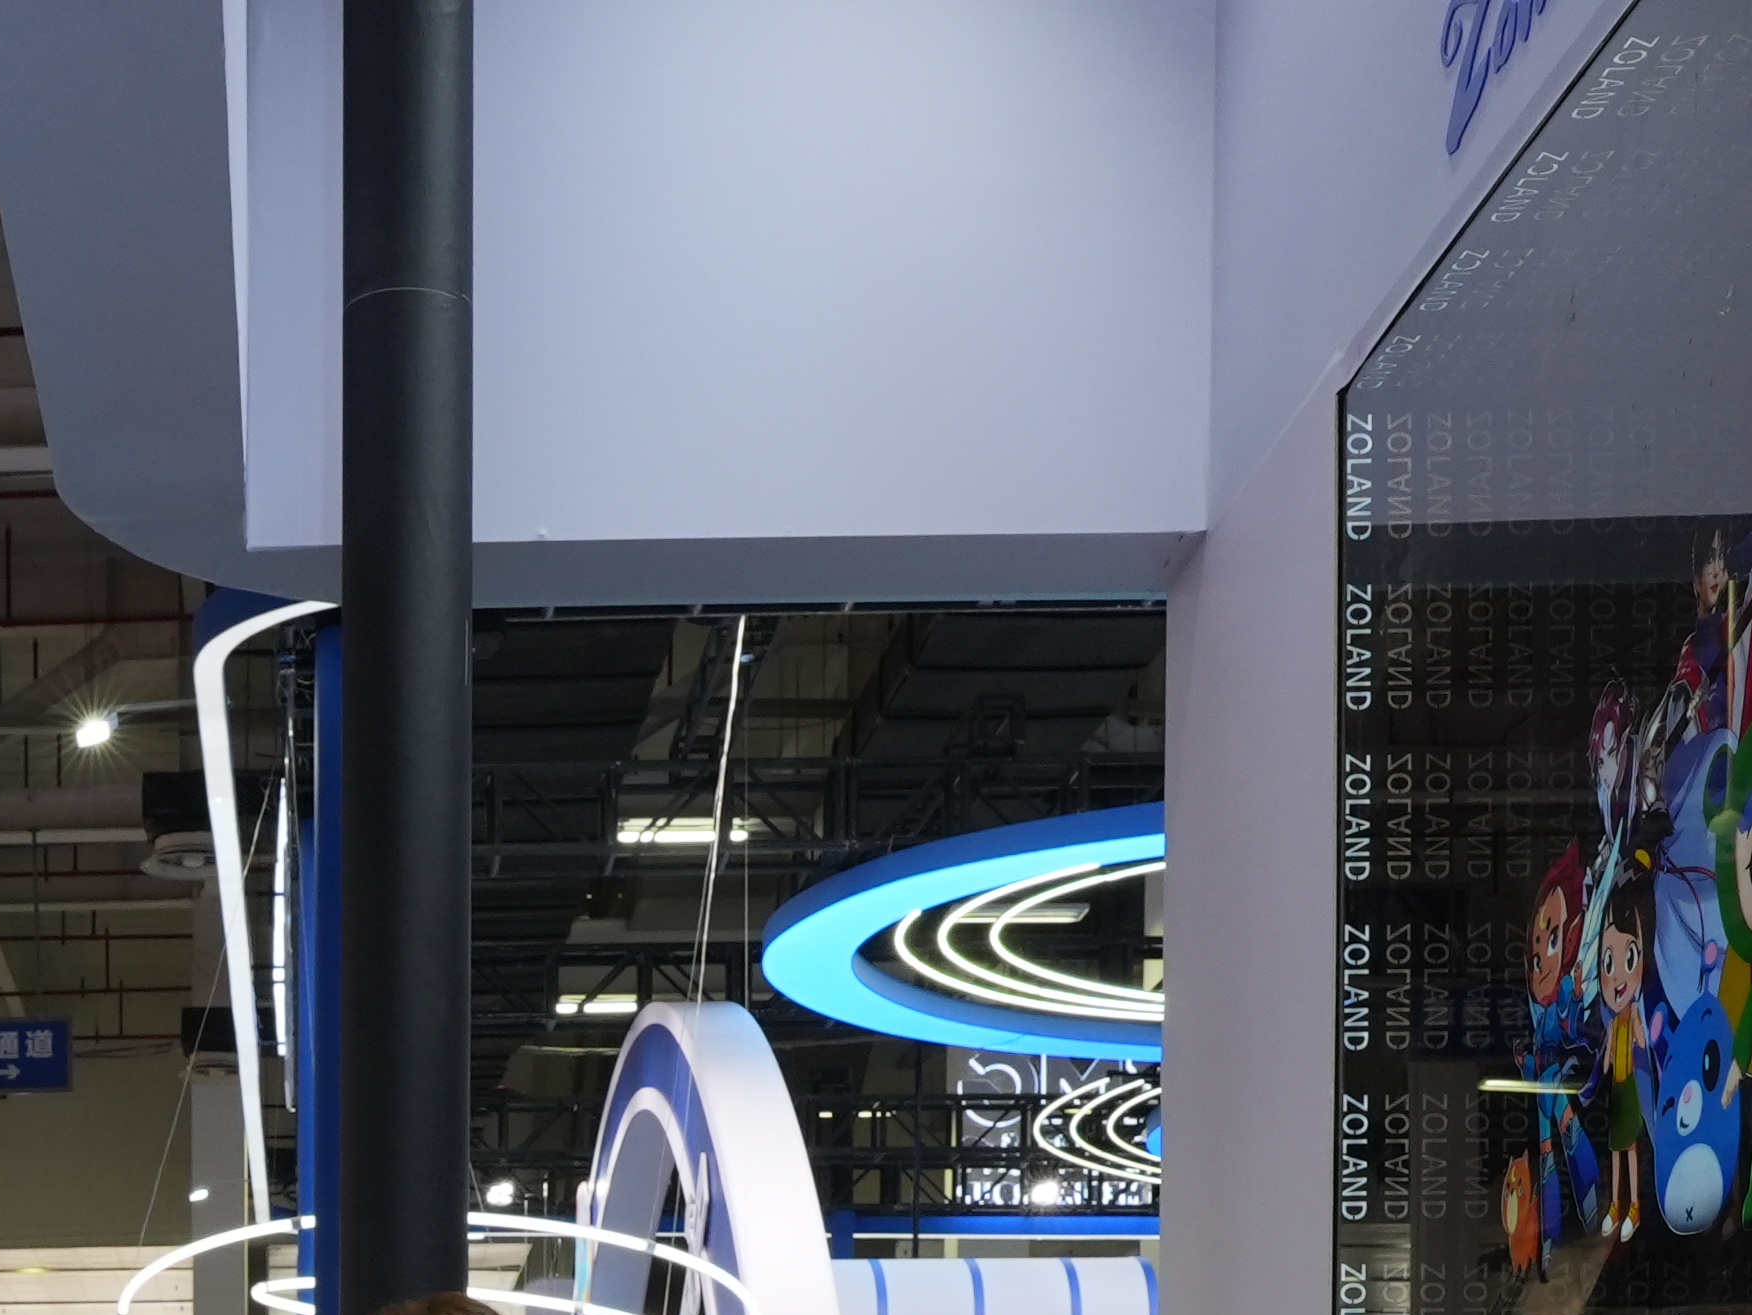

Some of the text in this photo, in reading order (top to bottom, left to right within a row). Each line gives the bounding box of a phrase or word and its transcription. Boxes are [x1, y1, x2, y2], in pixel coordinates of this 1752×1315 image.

[1571, 36, 1660, 119] ZOLAND
[1491, 151, 1568, 223] ZOLAND
[1346, 413, 1373, 541] ZOLAND
[1345, 584, 1372, 711] ZOLAND
[1344, 754, 1371, 881] ZOLAND
[1343, 925, 1369, 1051] ZOLAND
[1342, 1094, 1368, 1221] ZOLAND
